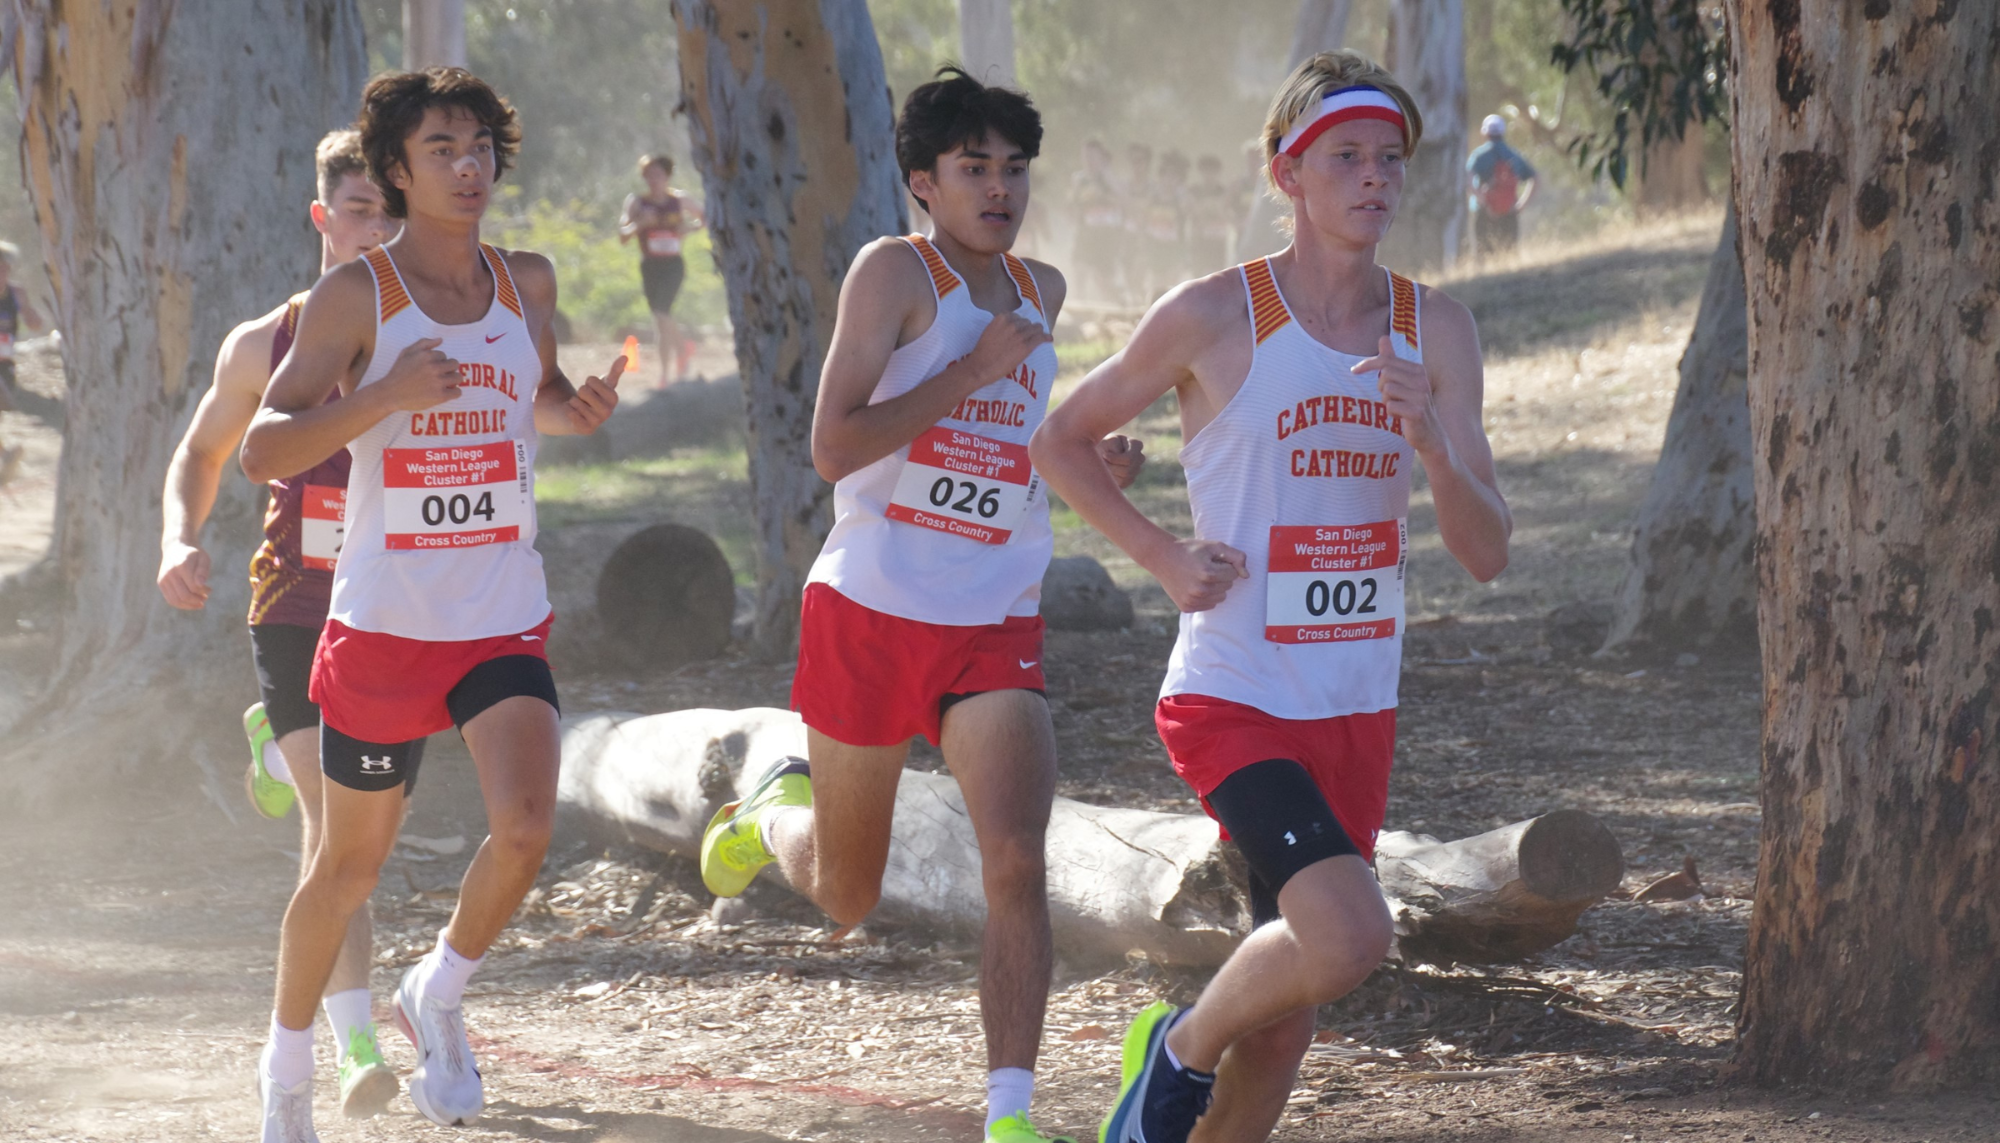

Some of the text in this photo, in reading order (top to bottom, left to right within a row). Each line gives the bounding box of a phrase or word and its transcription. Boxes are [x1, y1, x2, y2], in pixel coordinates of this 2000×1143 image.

[457, 363, 518, 402] EDRAL
[411, 409, 507, 436] CATHOLIC
[947, 398, 1025, 427] ATHOLIC
[1277, 395, 1405, 440] CATHEDRA
[933, 441, 1016, 468] Western League
[952, 432, 1001, 453] San Diego
[406, 459, 500, 474] Western League
[425, 448, 483, 462] San Diego
[944, 457, 1000, 477] Cluster #1
[1290, 449, 1400, 479] CATHOLIC
[424, 472, 485, 486] Cluster #1
[421, 491, 495, 526] 004
[929, 476, 1001, 519] 026
[913, 512, 993, 542] Cross Country
[1315, 528, 1372, 542] San Diego
[414, 533, 497, 547] Cross Country
[1295, 541, 1387, 555] Western League
[1311, 554, 1373, 569] Cluster #1
[1305, 577, 1378, 616] 002
[1297, 626, 1378, 640] Cross Country
